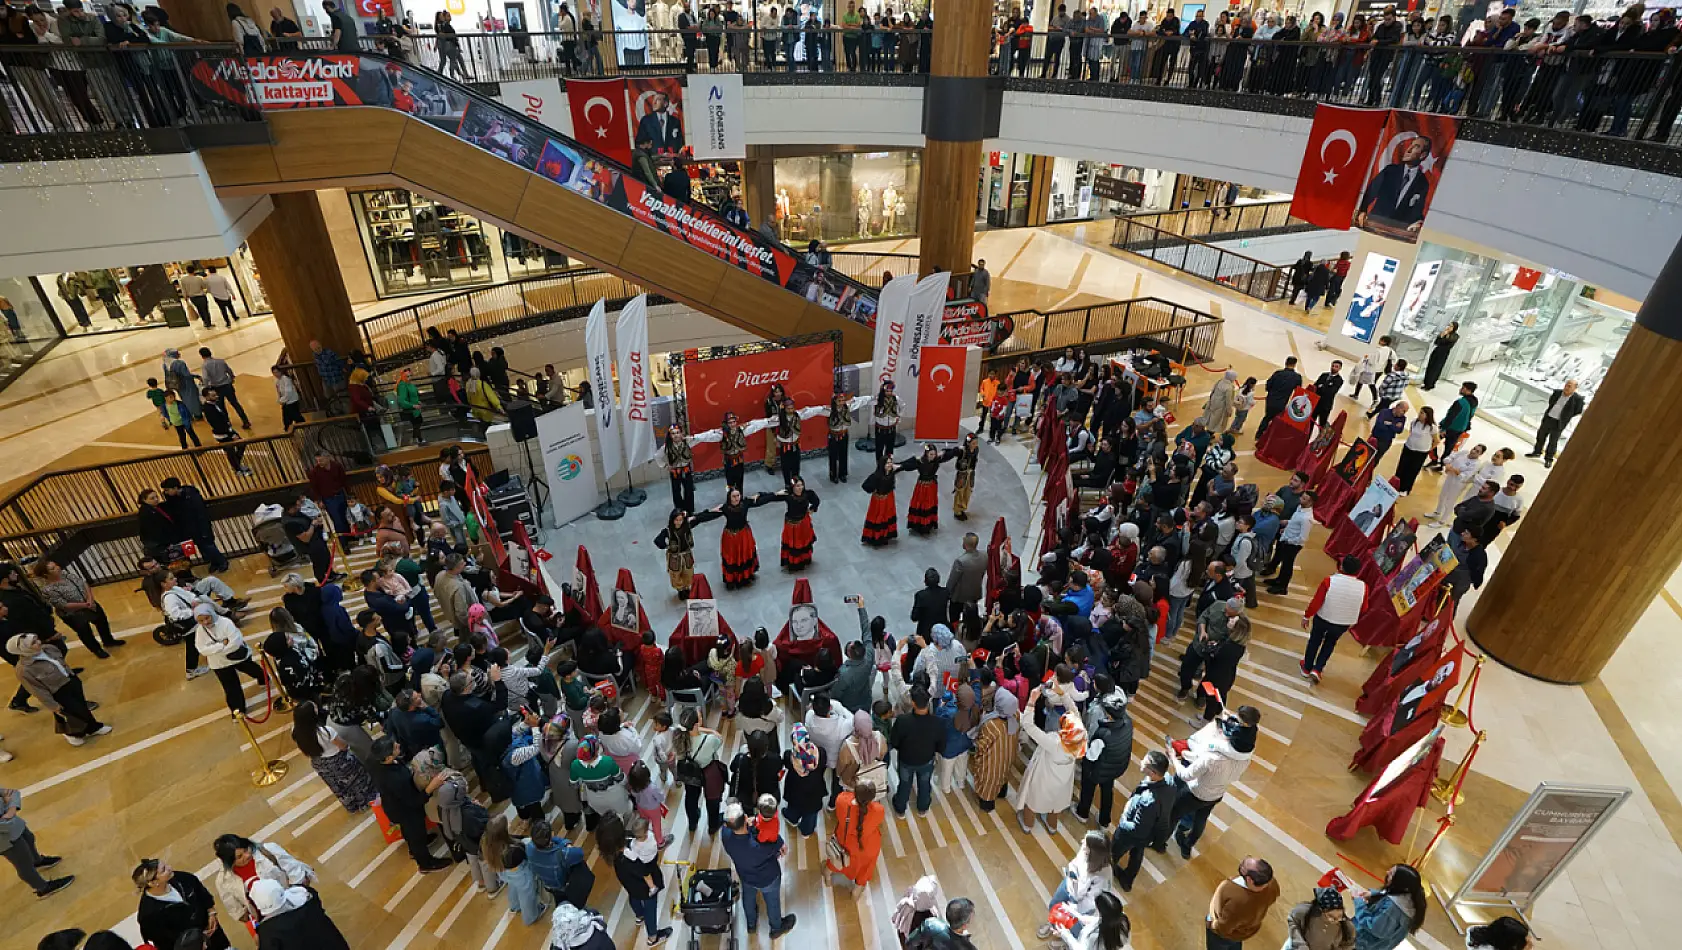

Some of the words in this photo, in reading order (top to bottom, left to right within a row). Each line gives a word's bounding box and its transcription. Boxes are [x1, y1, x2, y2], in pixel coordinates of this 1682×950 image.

[298, 58, 354, 79] Markt
[263, 85, 328, 101] kattayız!
[715, 104, 725, 150] RÖNESANS
[639, 190, 740, 249] Yapabileceklerini
[737, 237, 774, 265] keşfet.
[909, 313, 925, 360] RÖNESANS
[629, 351, 648, 421] Piazza
[734, 369, 790, 389] Piazza
